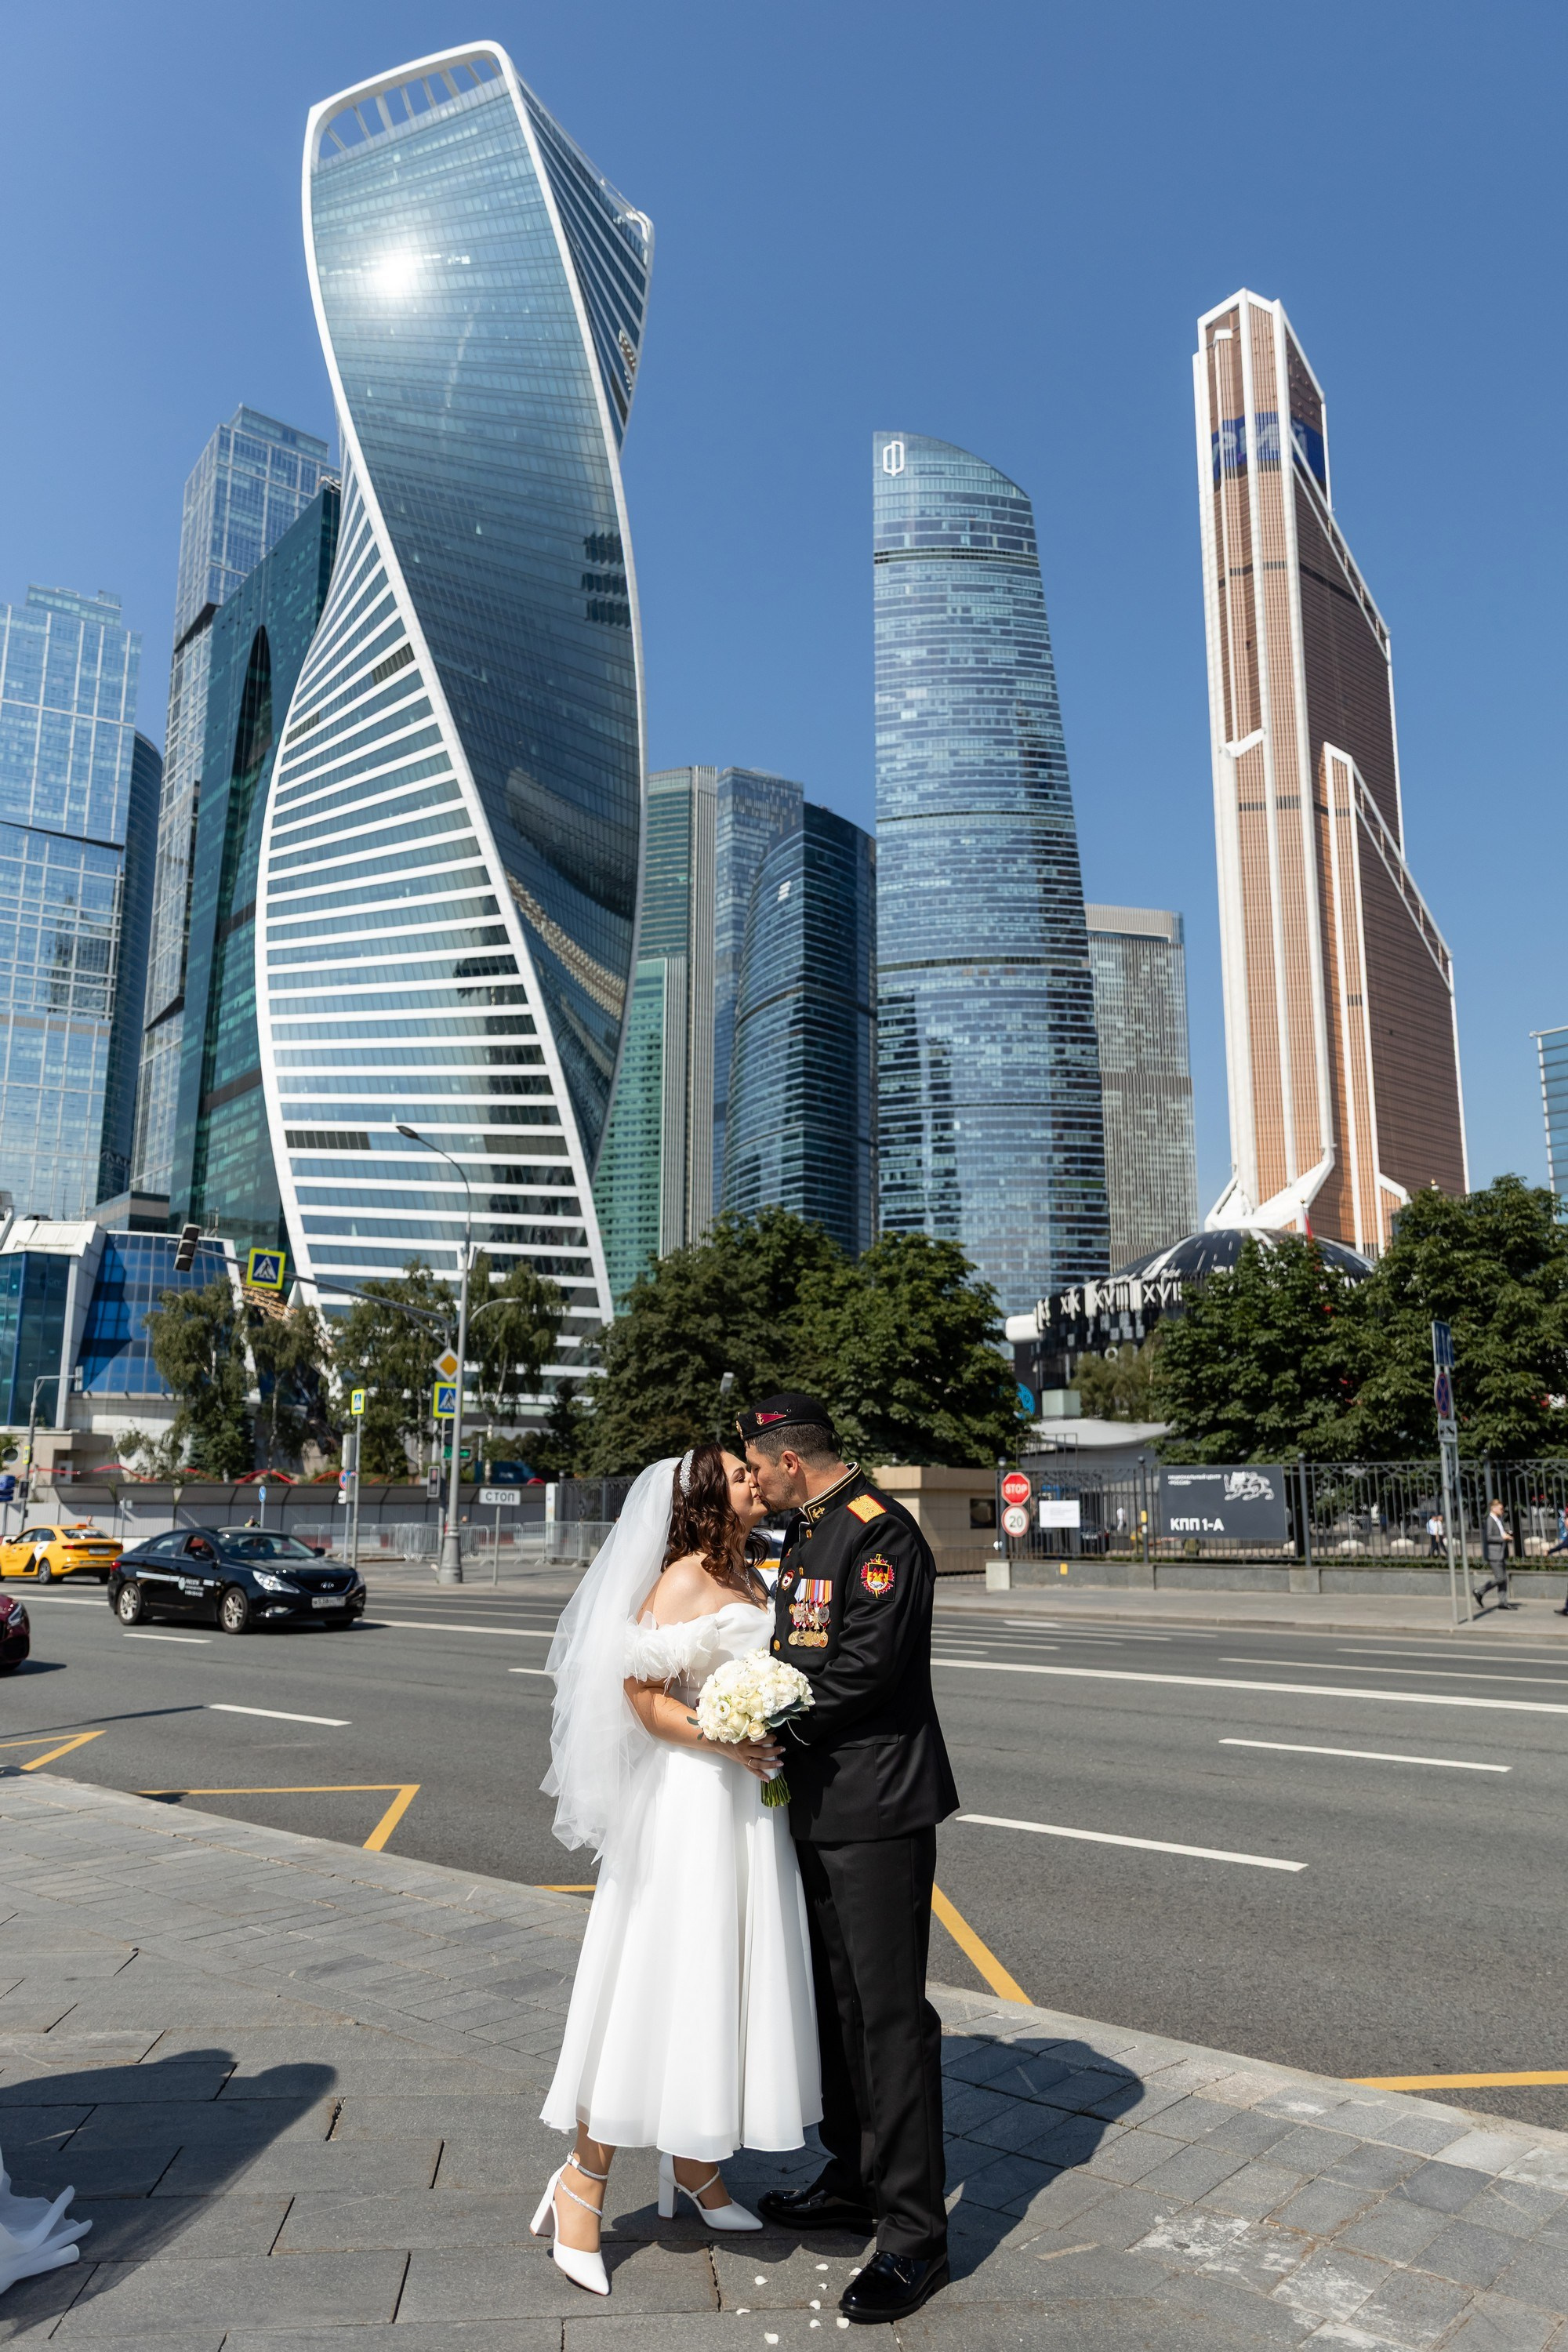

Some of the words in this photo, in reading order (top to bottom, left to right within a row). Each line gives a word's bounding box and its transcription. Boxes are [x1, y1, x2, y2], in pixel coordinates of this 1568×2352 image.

[1005, 1483, 1028, 1494] STOP
[485, 1491, 514, 1502] СТОП
[1009, 1515, 1023, 1528] 20
[1170, 1517, 1200, 1531] КПП
